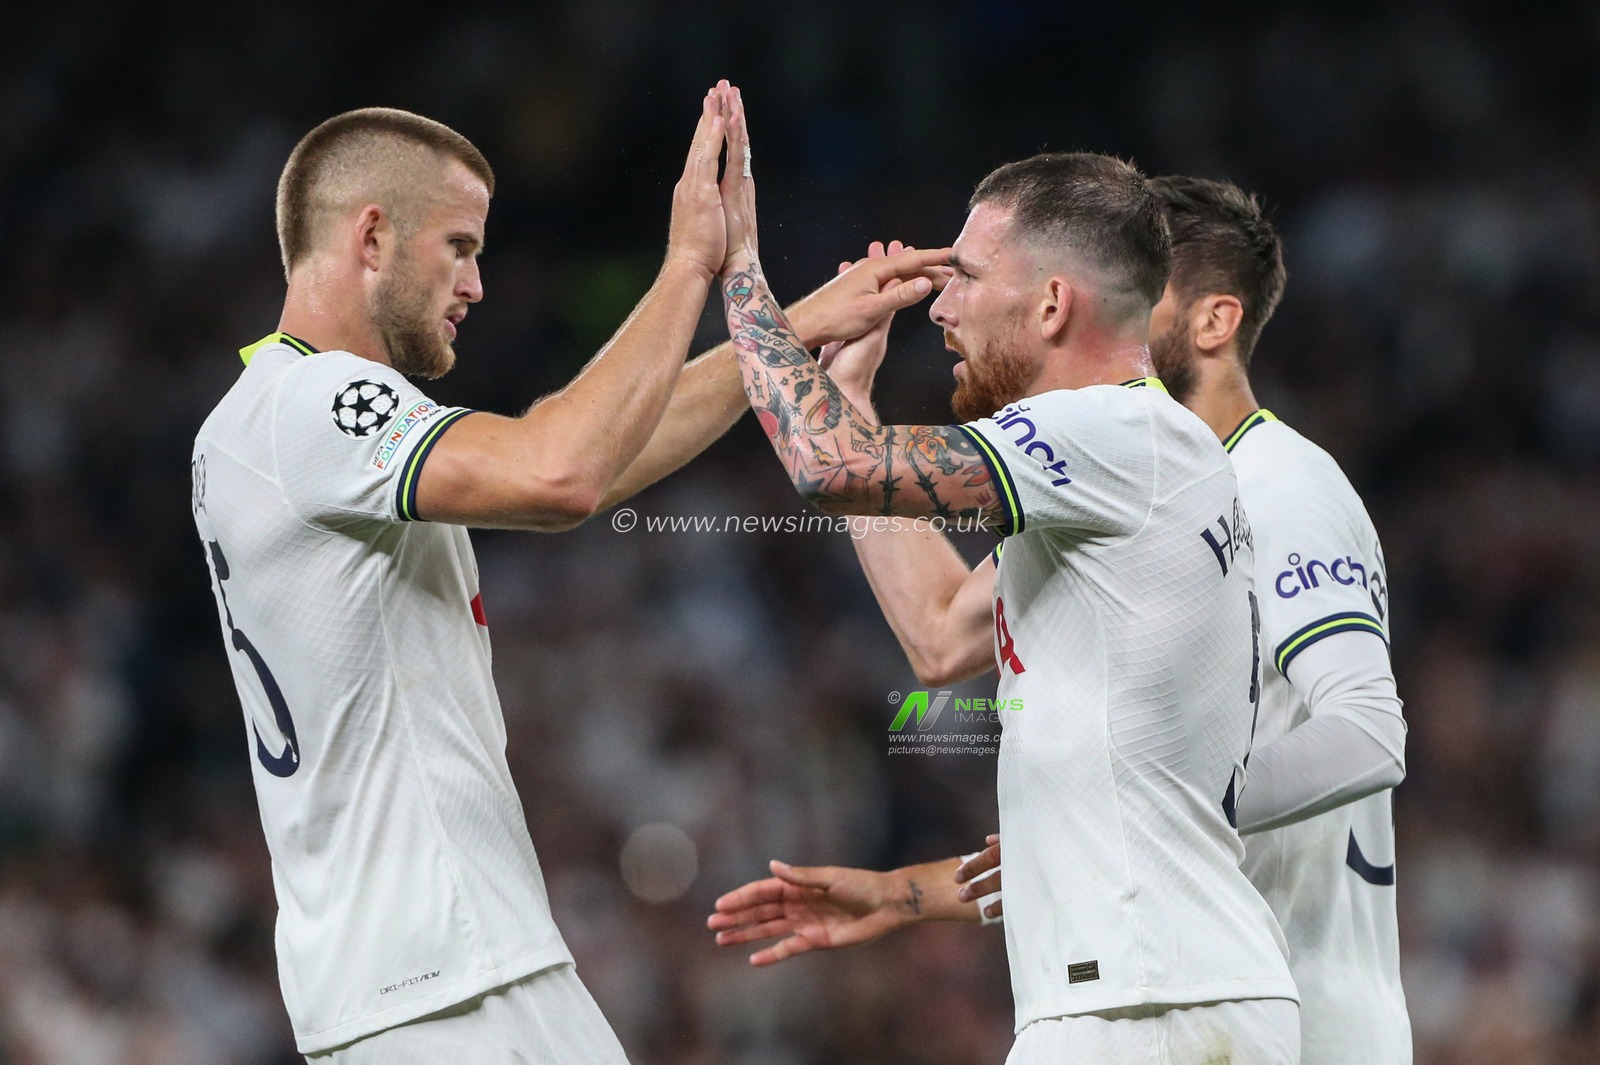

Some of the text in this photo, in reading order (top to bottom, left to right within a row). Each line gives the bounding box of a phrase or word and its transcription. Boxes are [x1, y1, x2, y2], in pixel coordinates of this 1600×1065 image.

[773, 339, 787, 349] OF
[377, 402, 436, 470] FOUNDATION
[372, 445, 385, 466] UEFA
[1275, 552, 1368, 599] cinch
